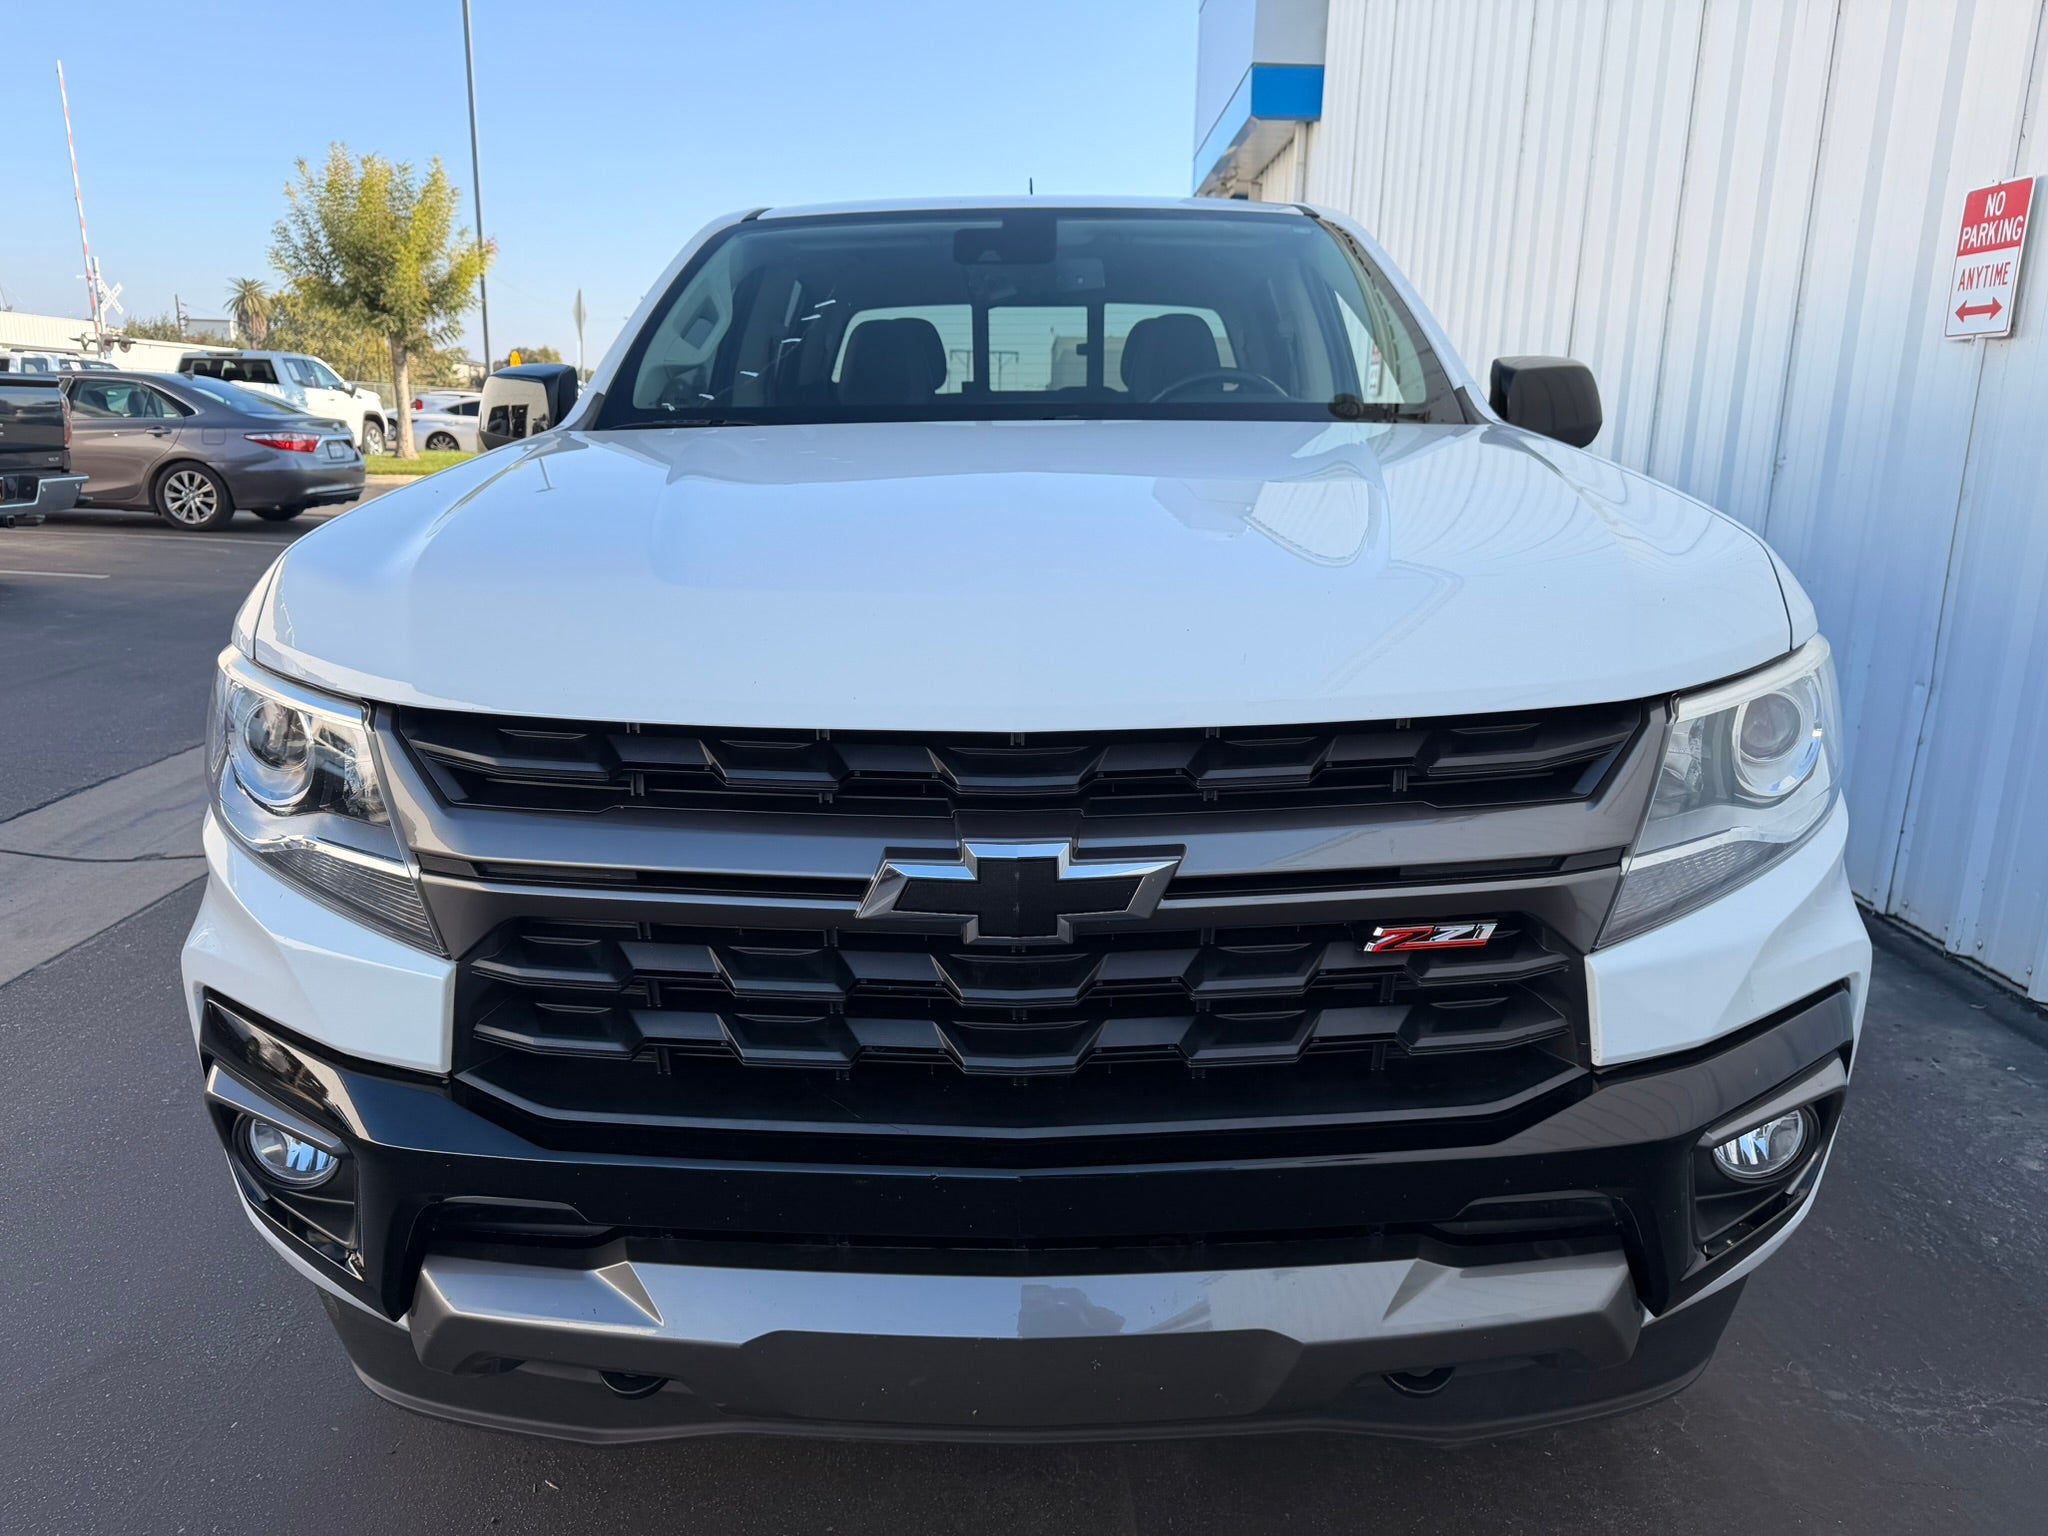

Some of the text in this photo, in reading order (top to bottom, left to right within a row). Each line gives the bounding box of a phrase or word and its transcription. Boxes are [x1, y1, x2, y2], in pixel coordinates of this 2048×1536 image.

[1984, 191, 2006, 218] NO
[1960, 215, 2023, 251] PARKING
[1957, 261, 2011, 292] ANYTIME
